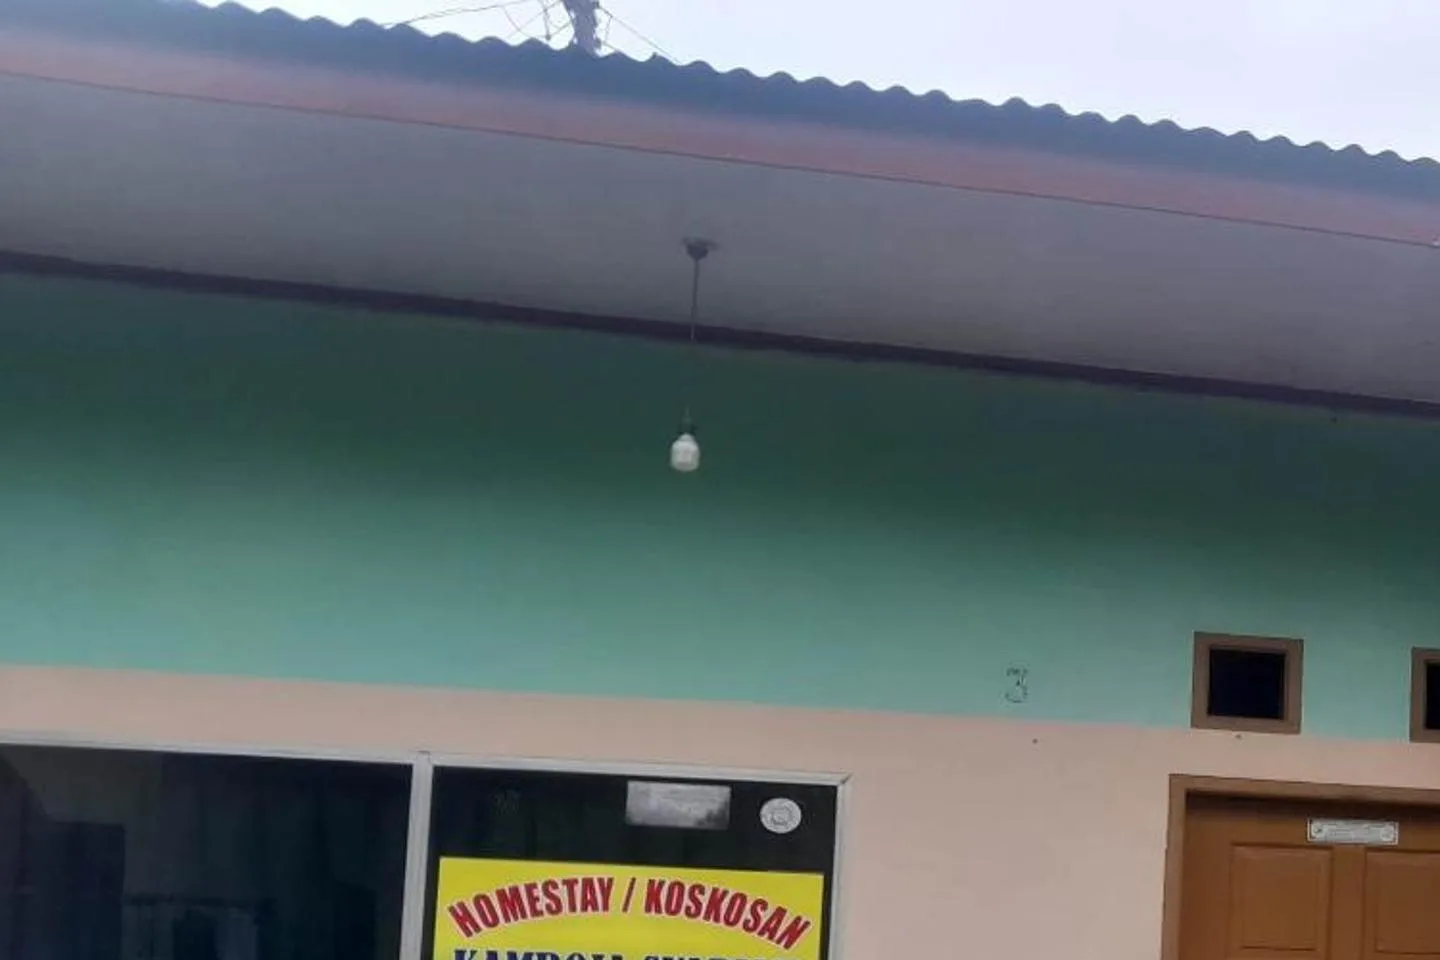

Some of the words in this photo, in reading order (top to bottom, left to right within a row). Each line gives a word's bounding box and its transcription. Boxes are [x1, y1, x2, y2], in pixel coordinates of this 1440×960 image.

[448, 877, 614, 938] HOMESTAY
[621, 877, 636, 913] /
[644, 879, 811, 950] KOSKOSAN
